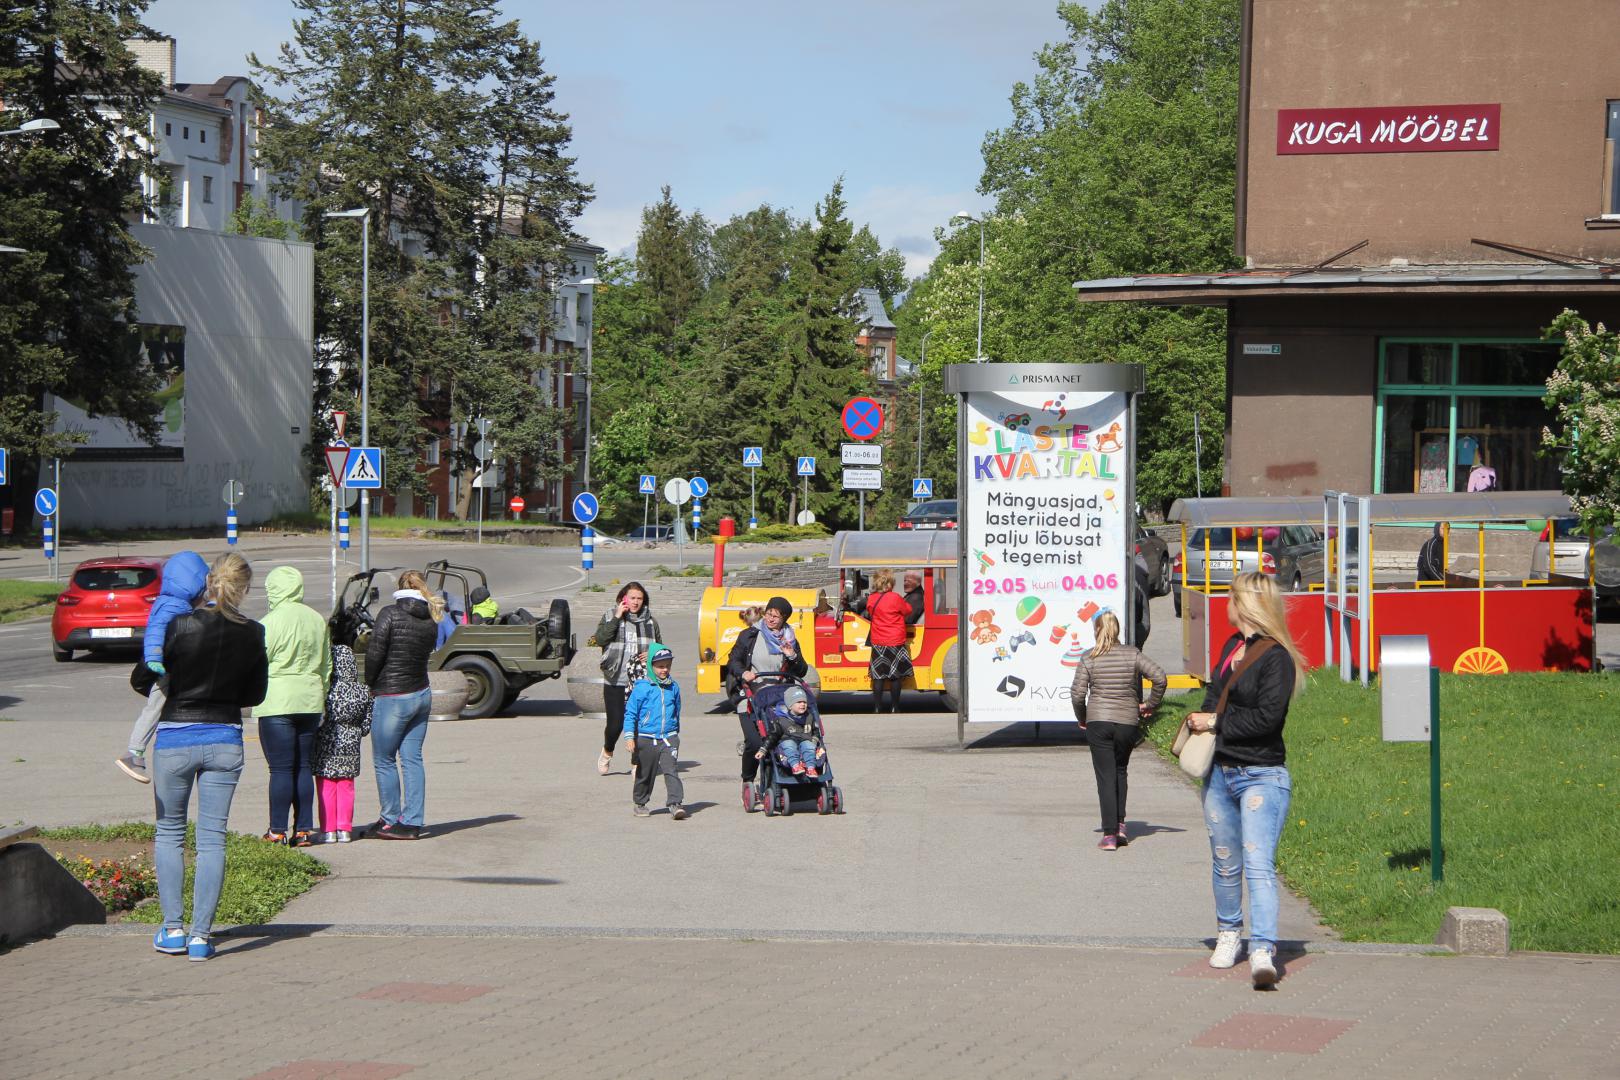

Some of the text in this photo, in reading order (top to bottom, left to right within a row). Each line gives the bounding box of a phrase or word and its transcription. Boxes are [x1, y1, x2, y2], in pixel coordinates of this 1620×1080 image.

[1288, 114, 1489, 145] KUGA MÖÖBEL
[1022, 374, 1082, 384] PRISMA NET
[994, 424, 1089, 455] LASTE
[974, 451, 1117, 480] KVARTAL
[987, 491, 1103, 512] Mänguasjad,
[986, 510, 1102, 531] lasteriided ja
[985, 530, 1102, 548] palju lõbusat
[1002, 548, 1083, 567] tegemist
[973, 573, 1119, 595] 29.05 kuni 04.06
[823, 675, 858, 684] Tellimine
